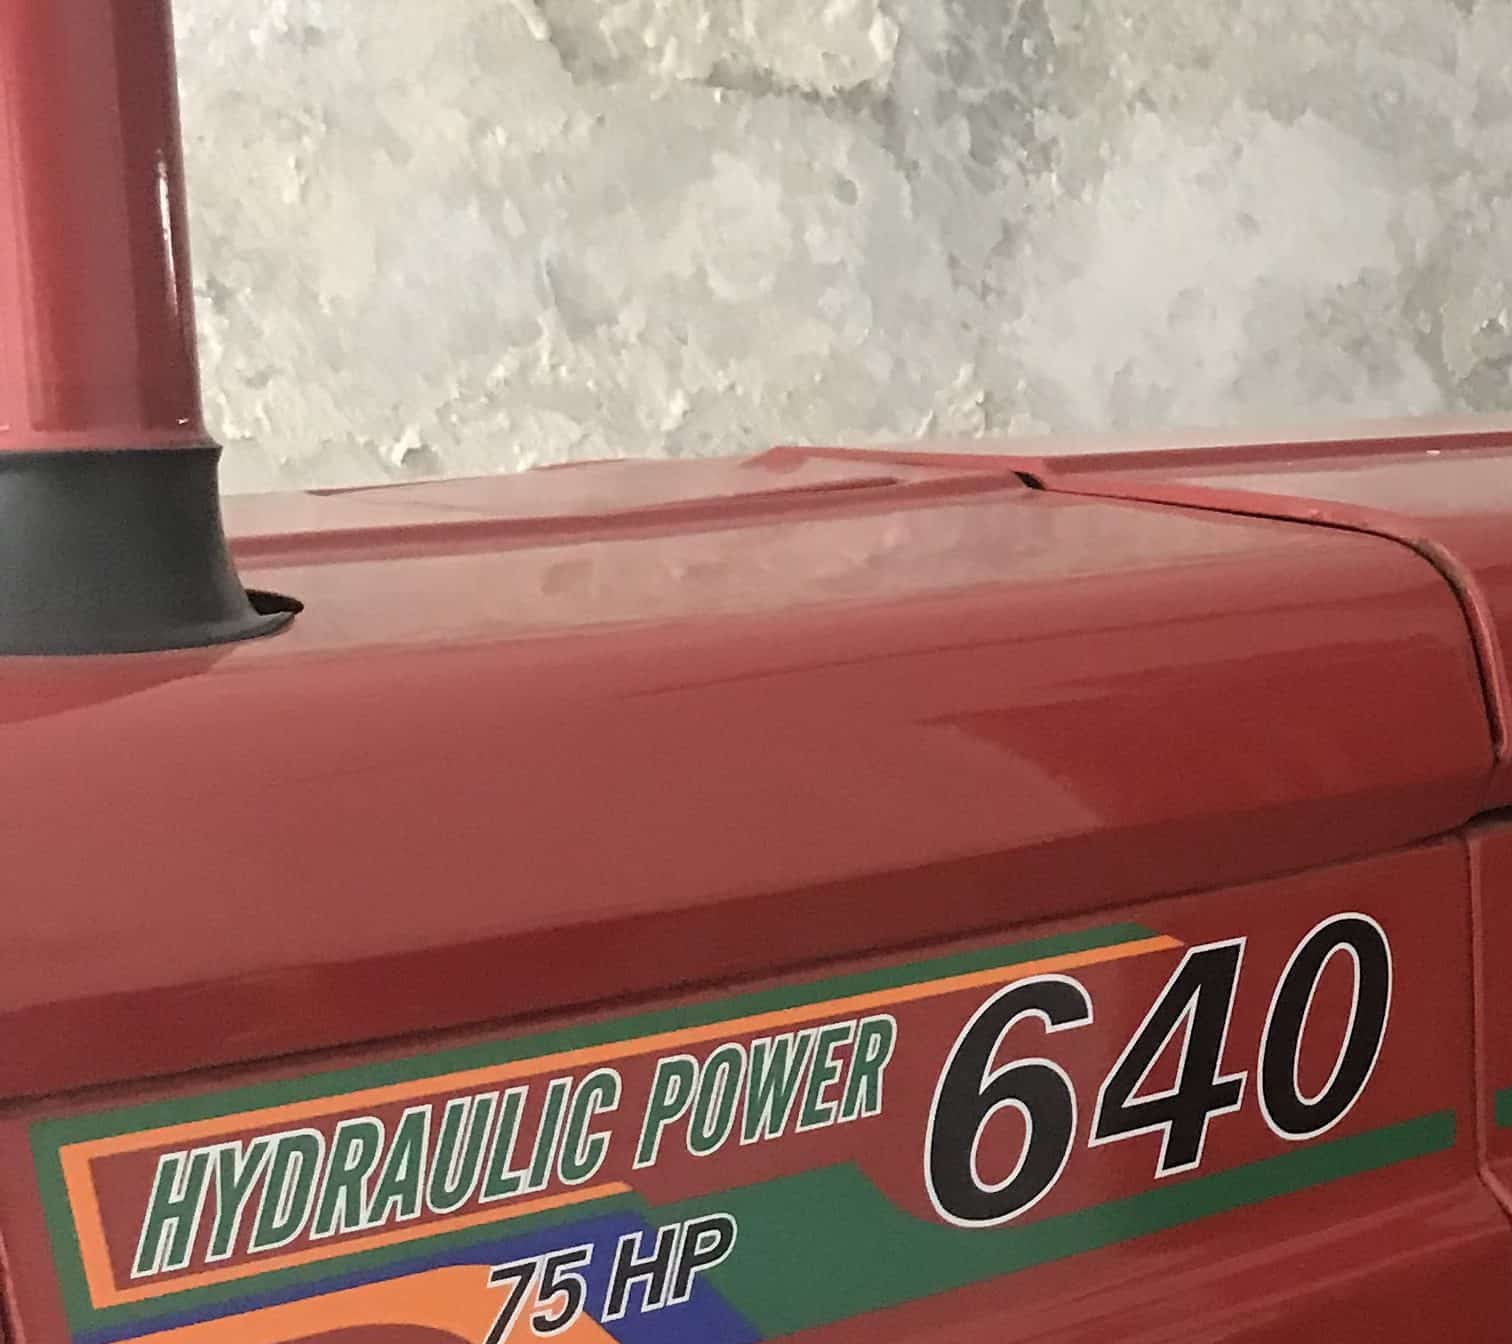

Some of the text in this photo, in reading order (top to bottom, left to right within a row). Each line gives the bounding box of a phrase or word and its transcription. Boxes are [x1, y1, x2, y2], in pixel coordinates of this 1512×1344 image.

[130, 1013, 898, 1279] HYDRAULIC POWER
[923, 911, 1393, 1229] 640
[601, 1213, 738, 1323] HP
